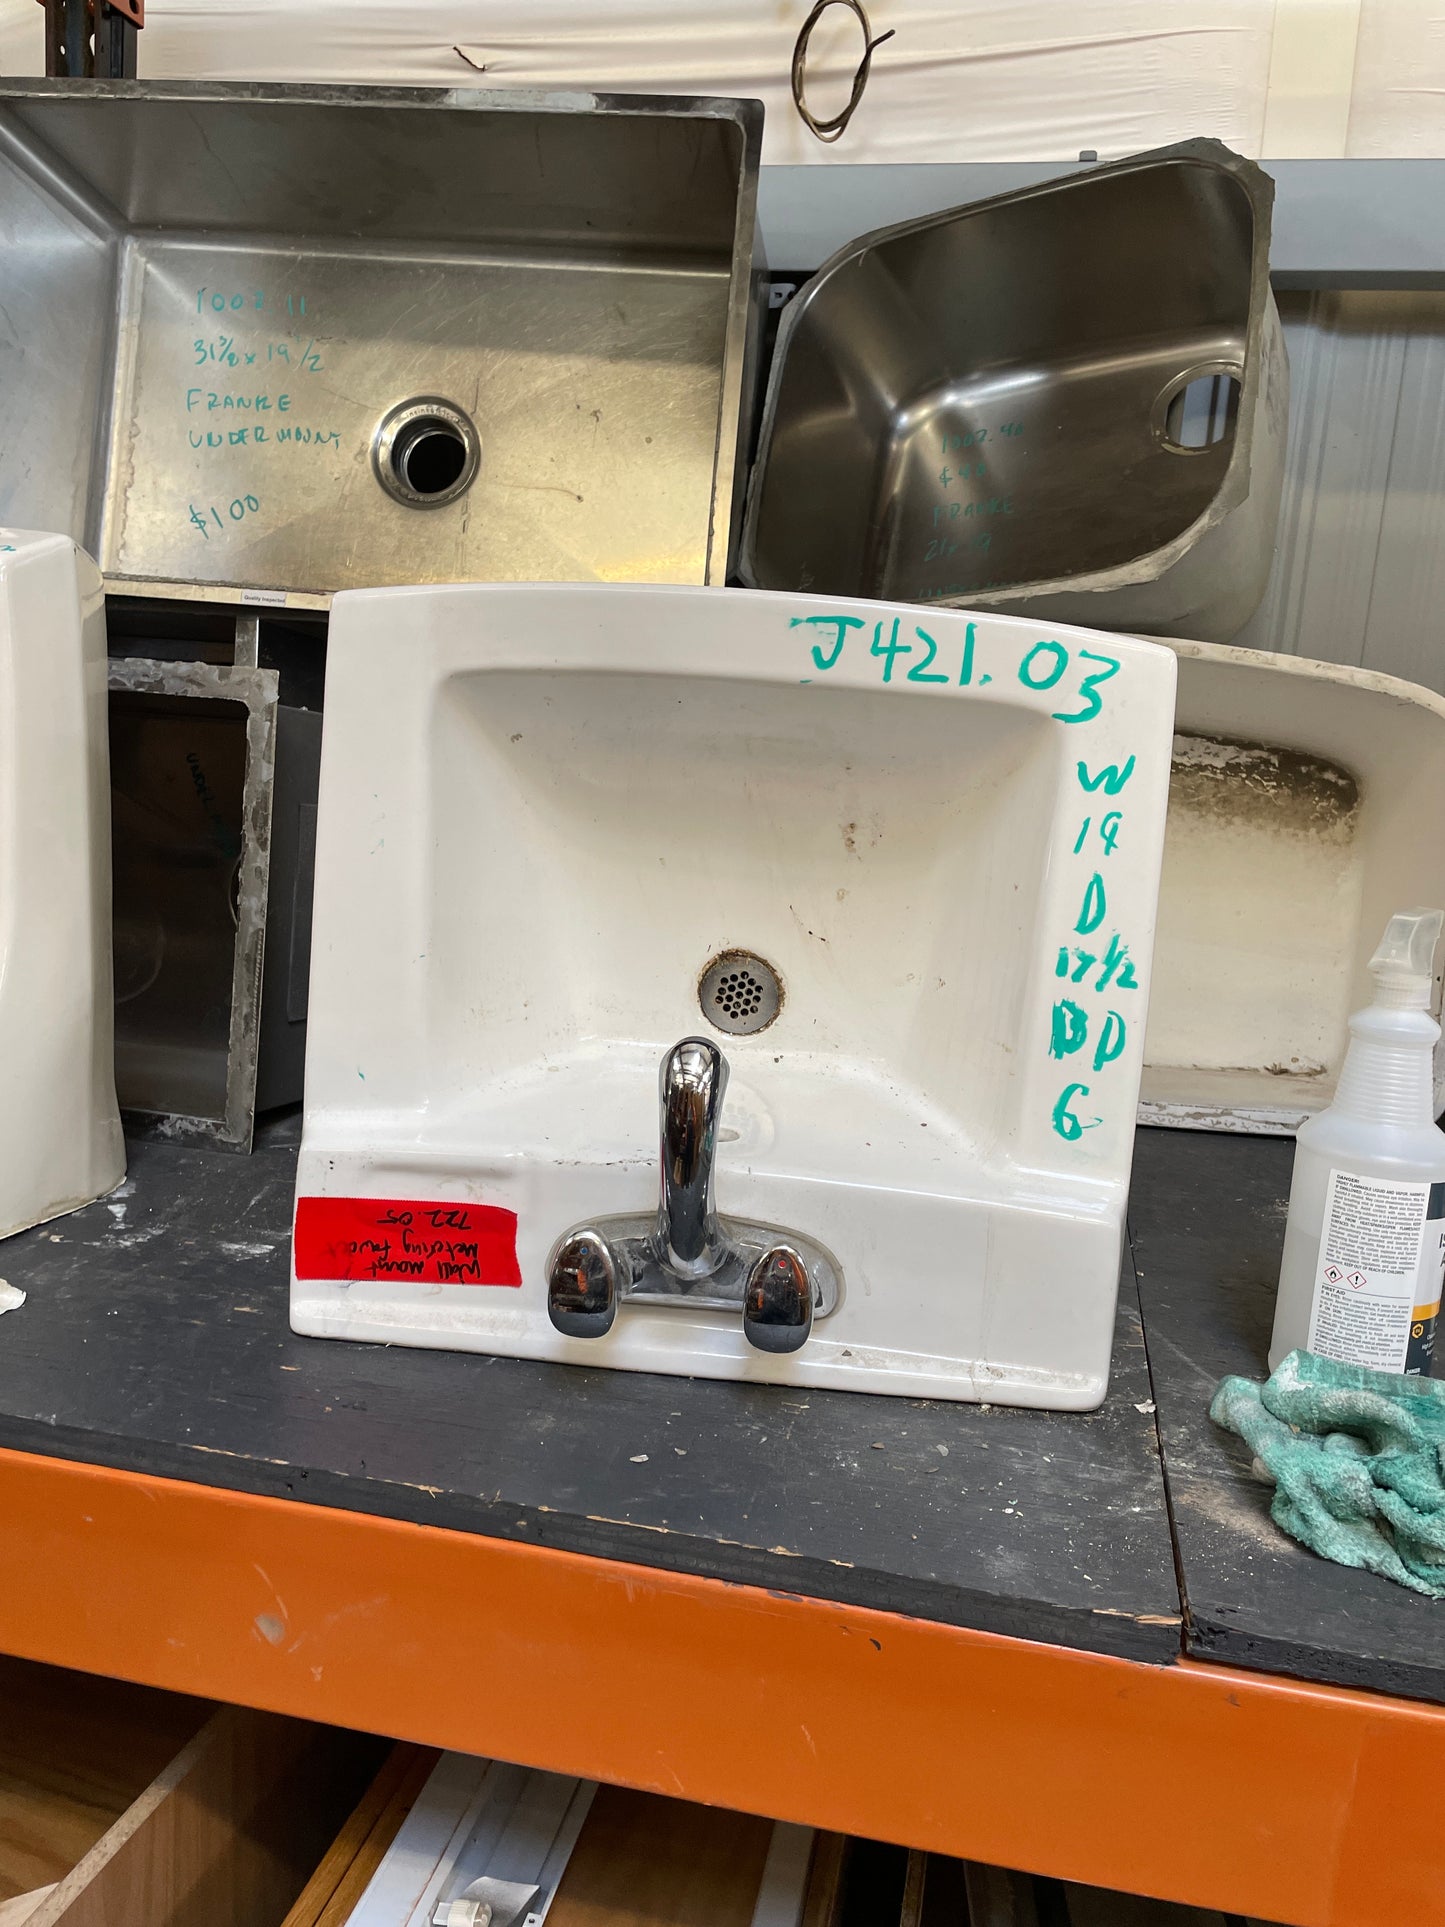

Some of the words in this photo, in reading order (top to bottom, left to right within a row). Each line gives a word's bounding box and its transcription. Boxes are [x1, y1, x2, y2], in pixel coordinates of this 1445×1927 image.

[186, 388, 292, 413] FRANKE
[189, 493, 260, 540] $100
[244, 594, 261, 602] Quality
[788, 615, 1122, 724] J421.03
[1076, 754, 1136, 796] W
[1072, 810, 1124, 857] 19
[1073, 870, 1107, 935] D
[376, 1209, 471, 1230] 722.05
[437, 1260, 481, 1284] Wall
[1321, 1284, 1334, 1292] FIRST
